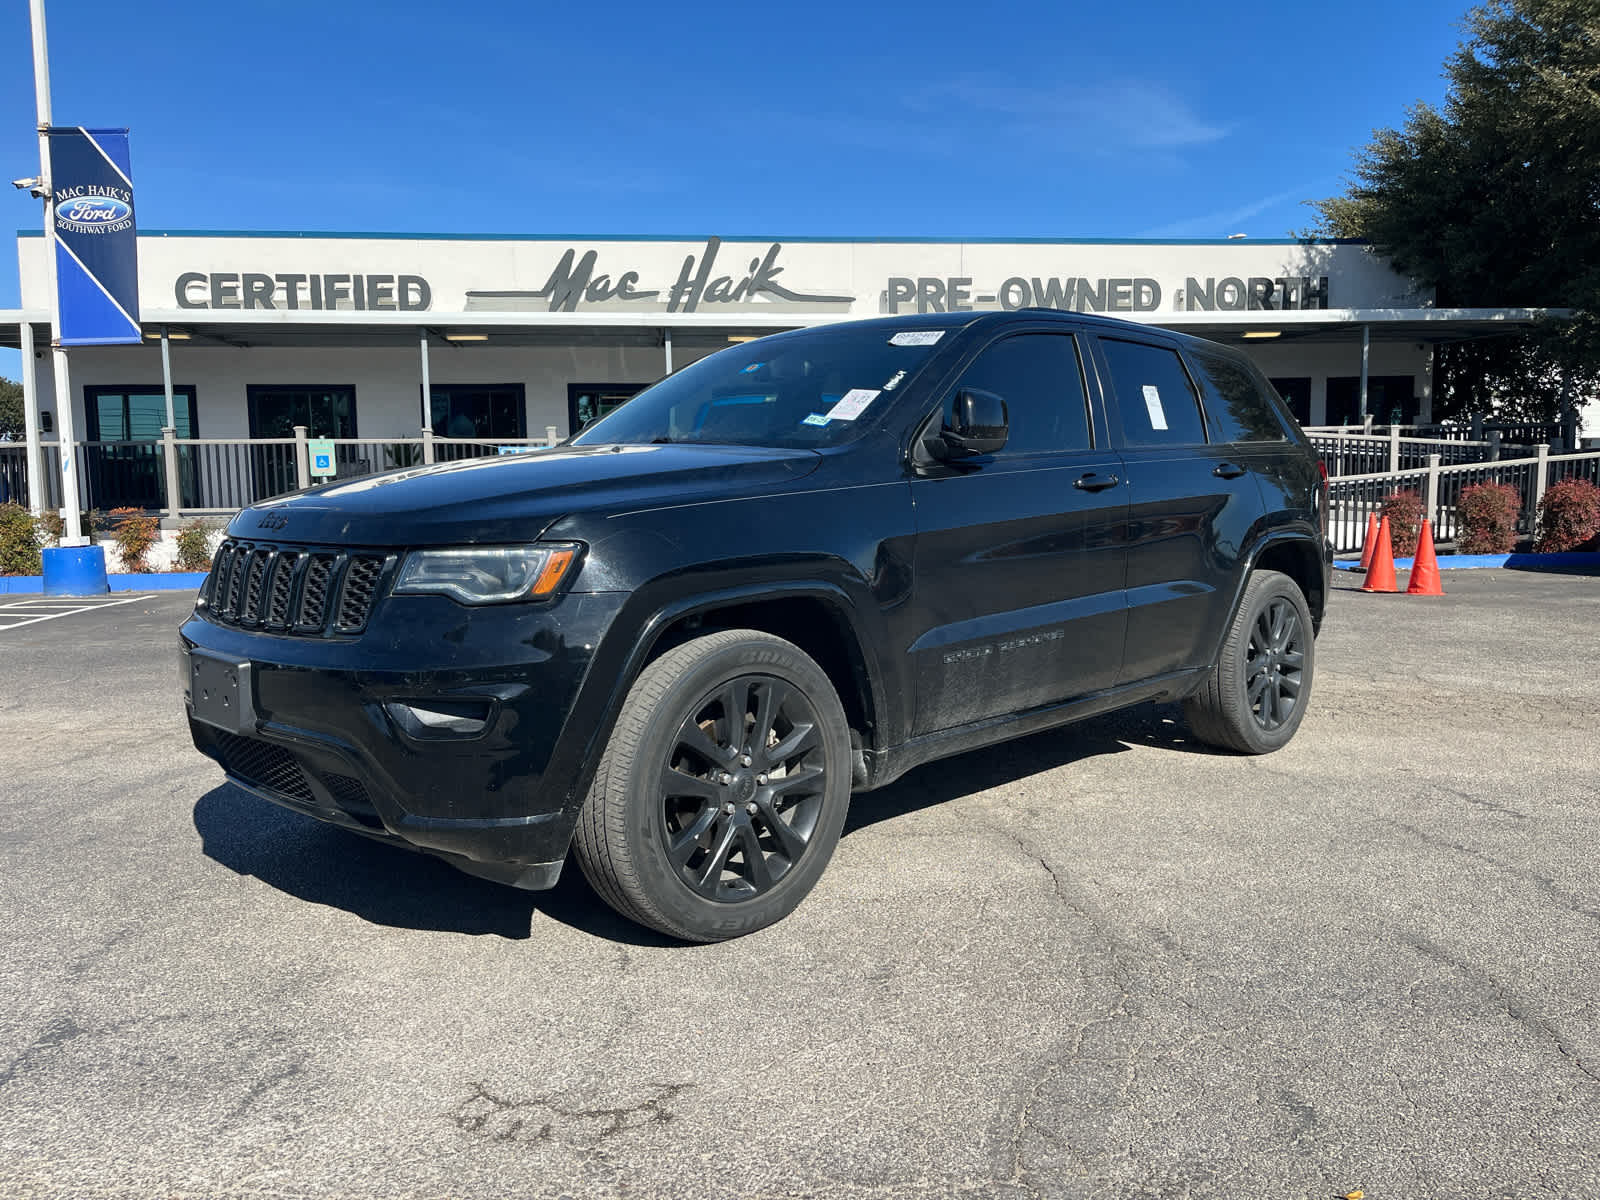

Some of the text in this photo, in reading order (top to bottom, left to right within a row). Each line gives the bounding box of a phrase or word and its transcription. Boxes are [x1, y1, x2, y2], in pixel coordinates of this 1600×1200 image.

[55, 185, 131, 202] MAC HAIK'S
[69, 200, 117, 220] Ford
[56, 219, 132, 234] SOUTHWAY FORD
[465, 236, 856, 314] Mac Haik
[174, 272, 432, 311] CERTIFIED
[886, 276, 1329, 314] PRE-OWNED NORTH
